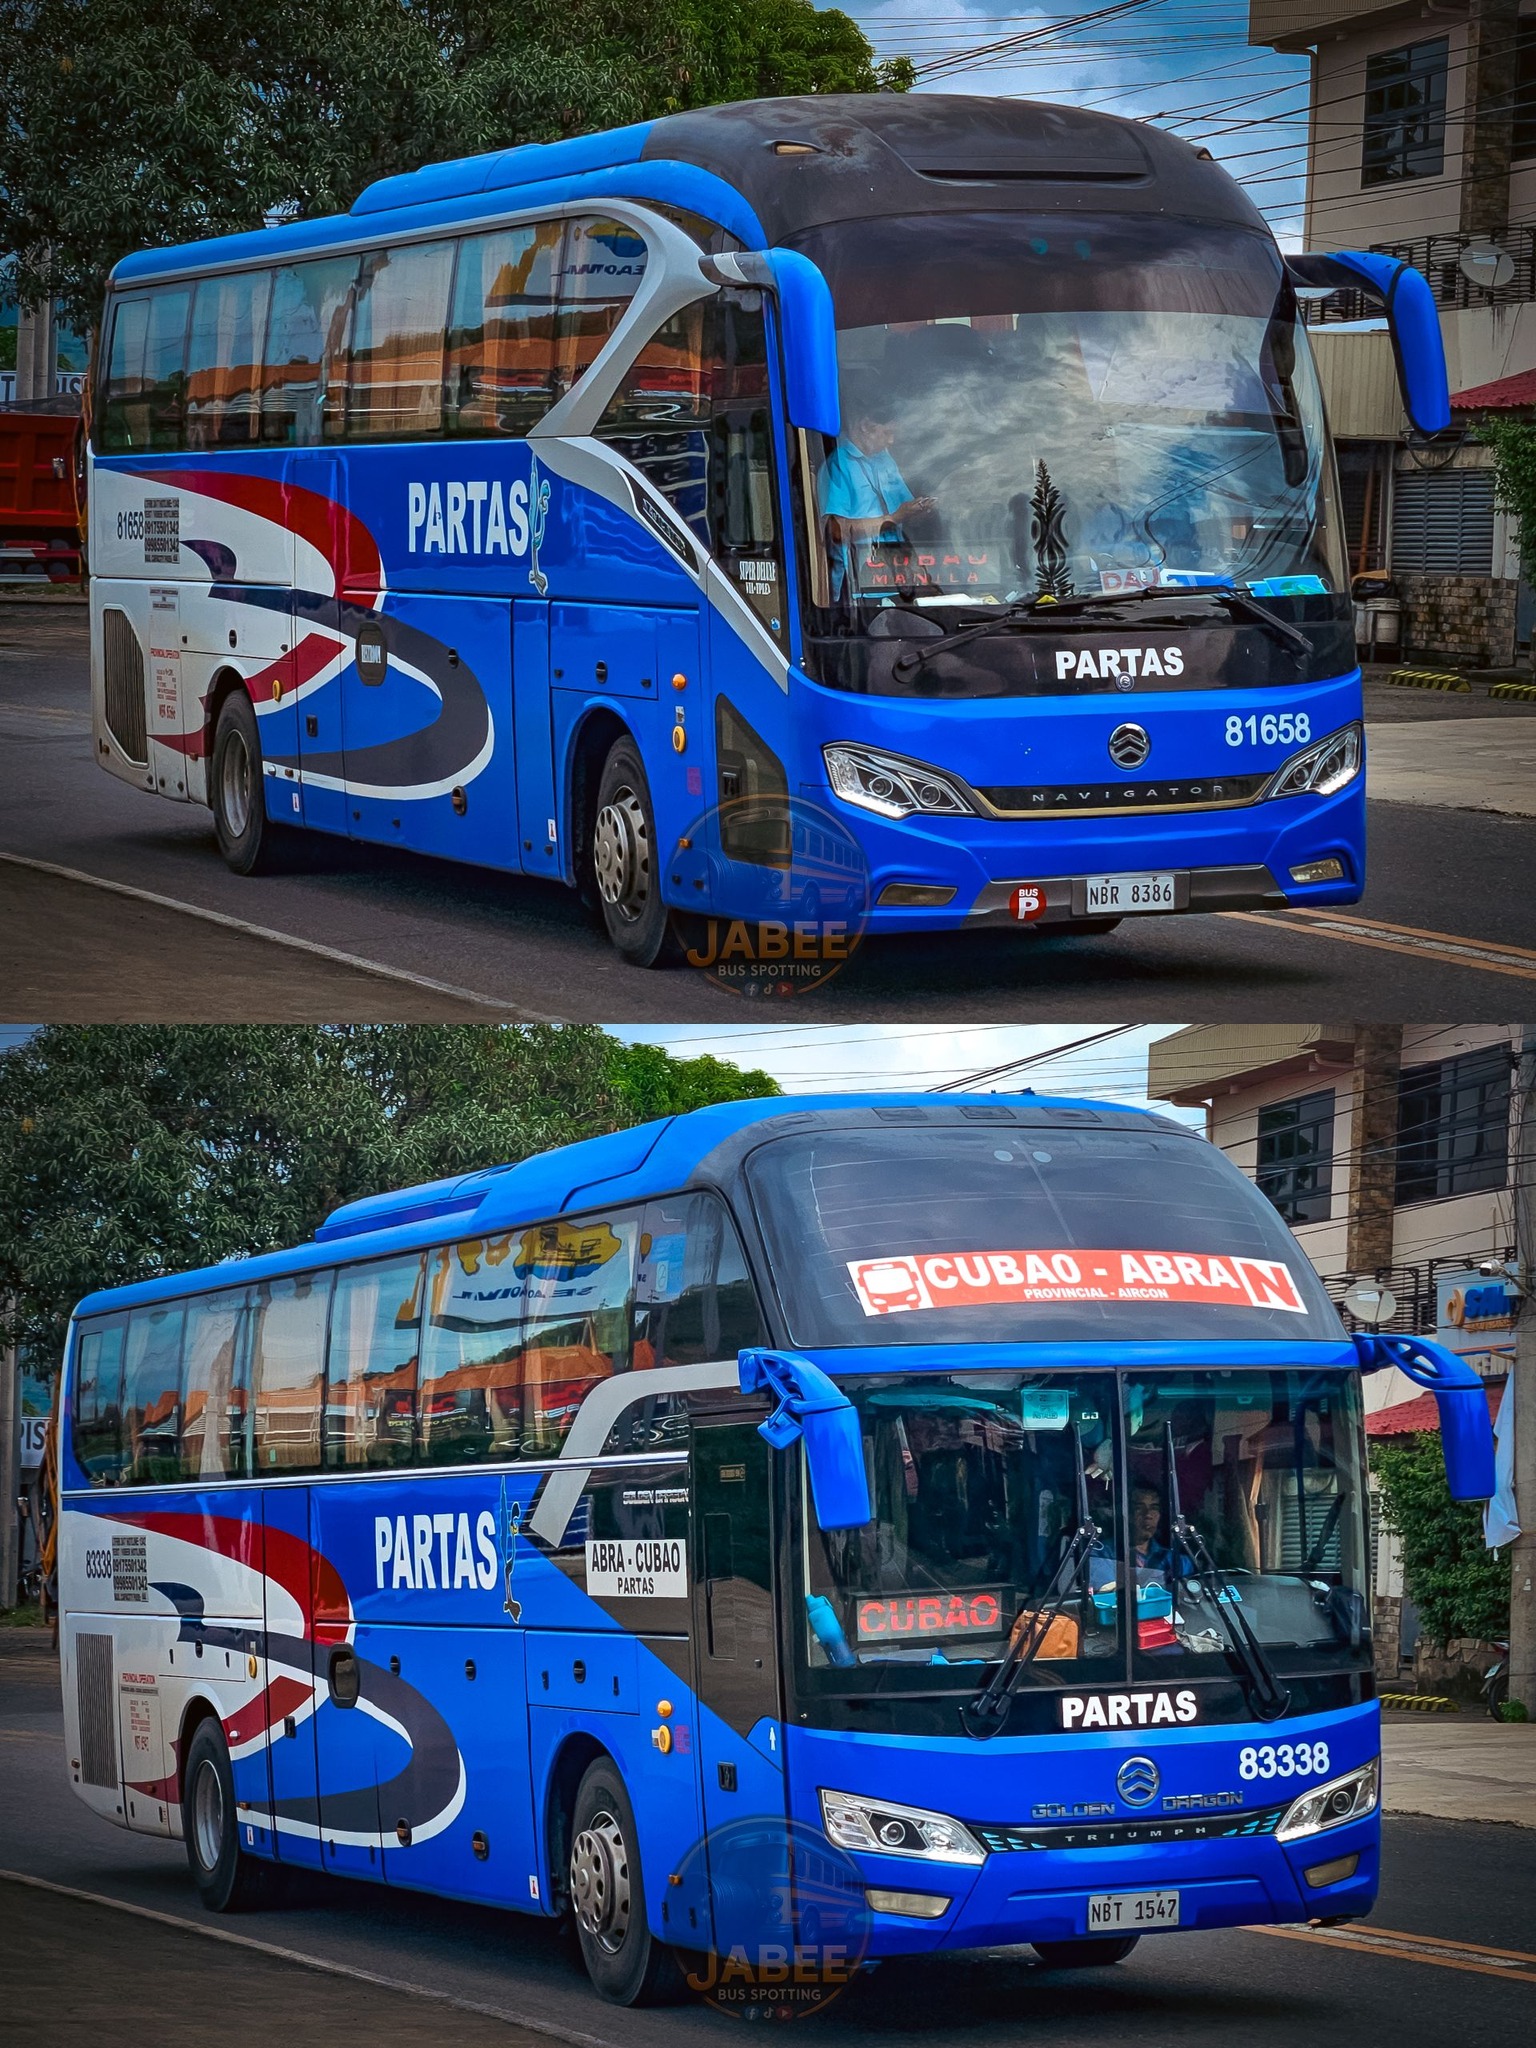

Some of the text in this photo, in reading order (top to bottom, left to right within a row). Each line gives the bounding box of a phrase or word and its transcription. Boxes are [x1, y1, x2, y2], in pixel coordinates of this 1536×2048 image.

[117, 511, 144, 540] 81658
[408, 479, 529, 556] PARTAS
[871, 571, 979, 585] MANILA
[1055, 646, 1185, 680] PARTAS
[1225, 711, 1311, 747] 81658
[1031, 785, 1223, 802] NAVIGATOR
[1018, 888, 1039, 898] BUS
[1089, 883, 1172, 905] NBR 8386
[1017, 897, 1040, 920] P
[923, 1253, 1082, 1290] CUBAO
[1122, 1253, 1242, 1290] ABRA
[1023, 1287, 1108, 1299] PROVINCIAL
[1117, 1287, 1169, 1299] AIRCON
[86, 1549, 112, 1579] 83338
[375, 1510, 498, 1591] PARTAS
[591, 1543, 625, 1573] ABRA
[635, 1542, 681, 1573] CUBAO
[617, 1576, 655, 1595] PARTAS
[859, 1594, 999, 1633] CUBAO
[1061, 1689, 1198, 1729] PARTAS
[1239, 1741, 1330, 1780] 83338
[1032, 1790, 1244, 1819] GOLDEN DRAGON
[1064, 1826, 1206, 1843] TRIUMPH
[1091, 1898, 1177, 1923] NBT 1547
